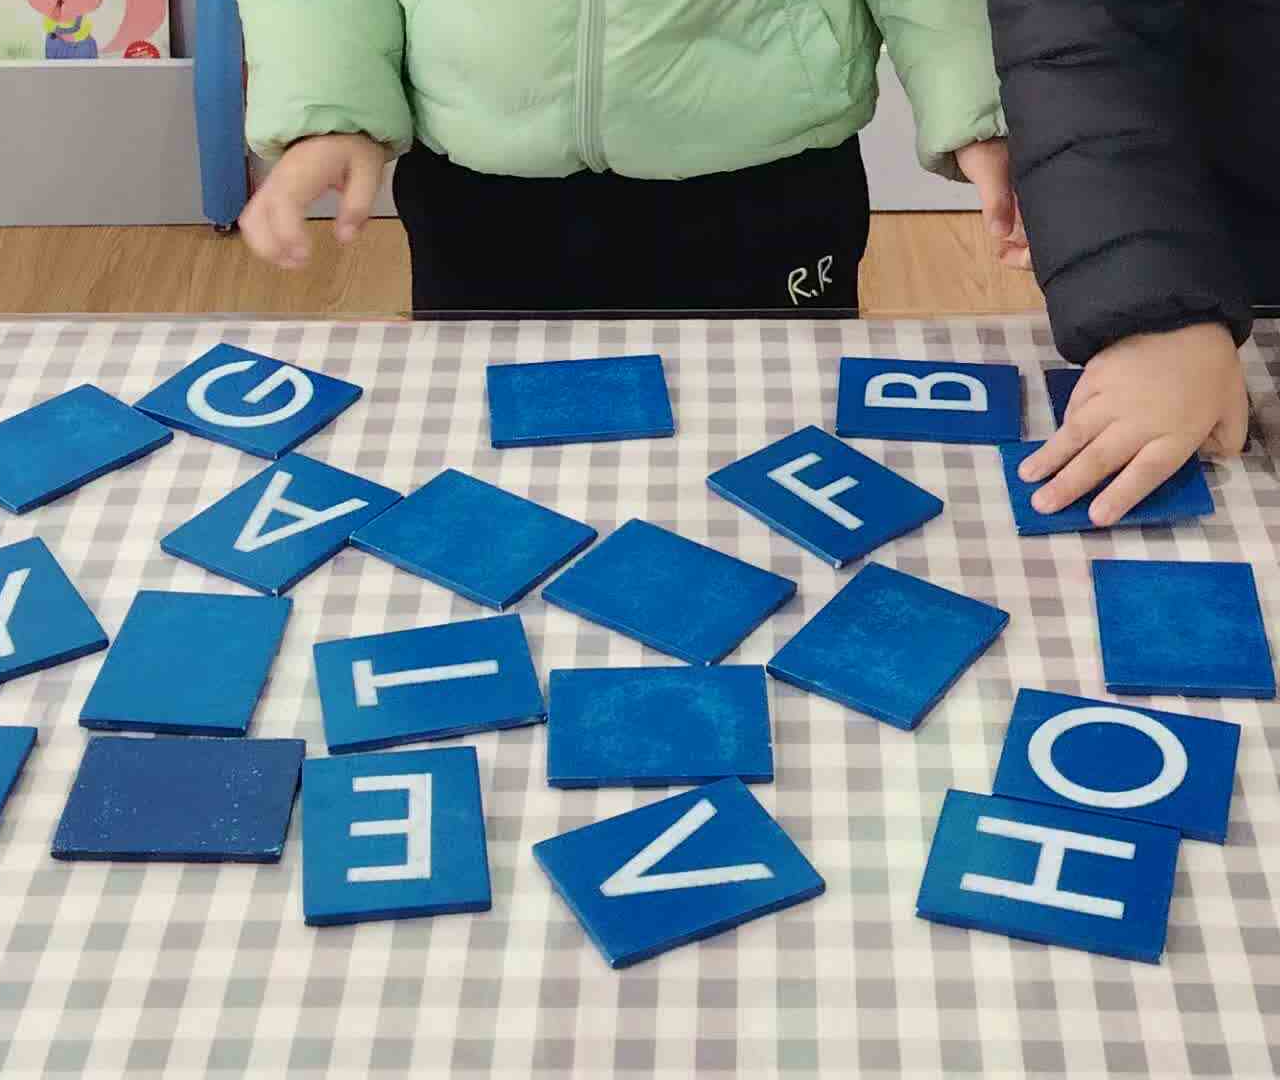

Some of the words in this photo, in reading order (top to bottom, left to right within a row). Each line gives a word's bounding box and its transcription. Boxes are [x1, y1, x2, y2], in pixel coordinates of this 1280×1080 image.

[186, 360, 314, 428] G
[864, 371, 989, 412] B
[233, 468, 370, 553] A
[766, 452, 864, 531] F
[351, 658, 500, 708] T
[1027, 706, 1188, 809] O
[346, 772, 433, 883] E
[599, 797, 776, 897] V
[960, 815, 1136, 920] H
